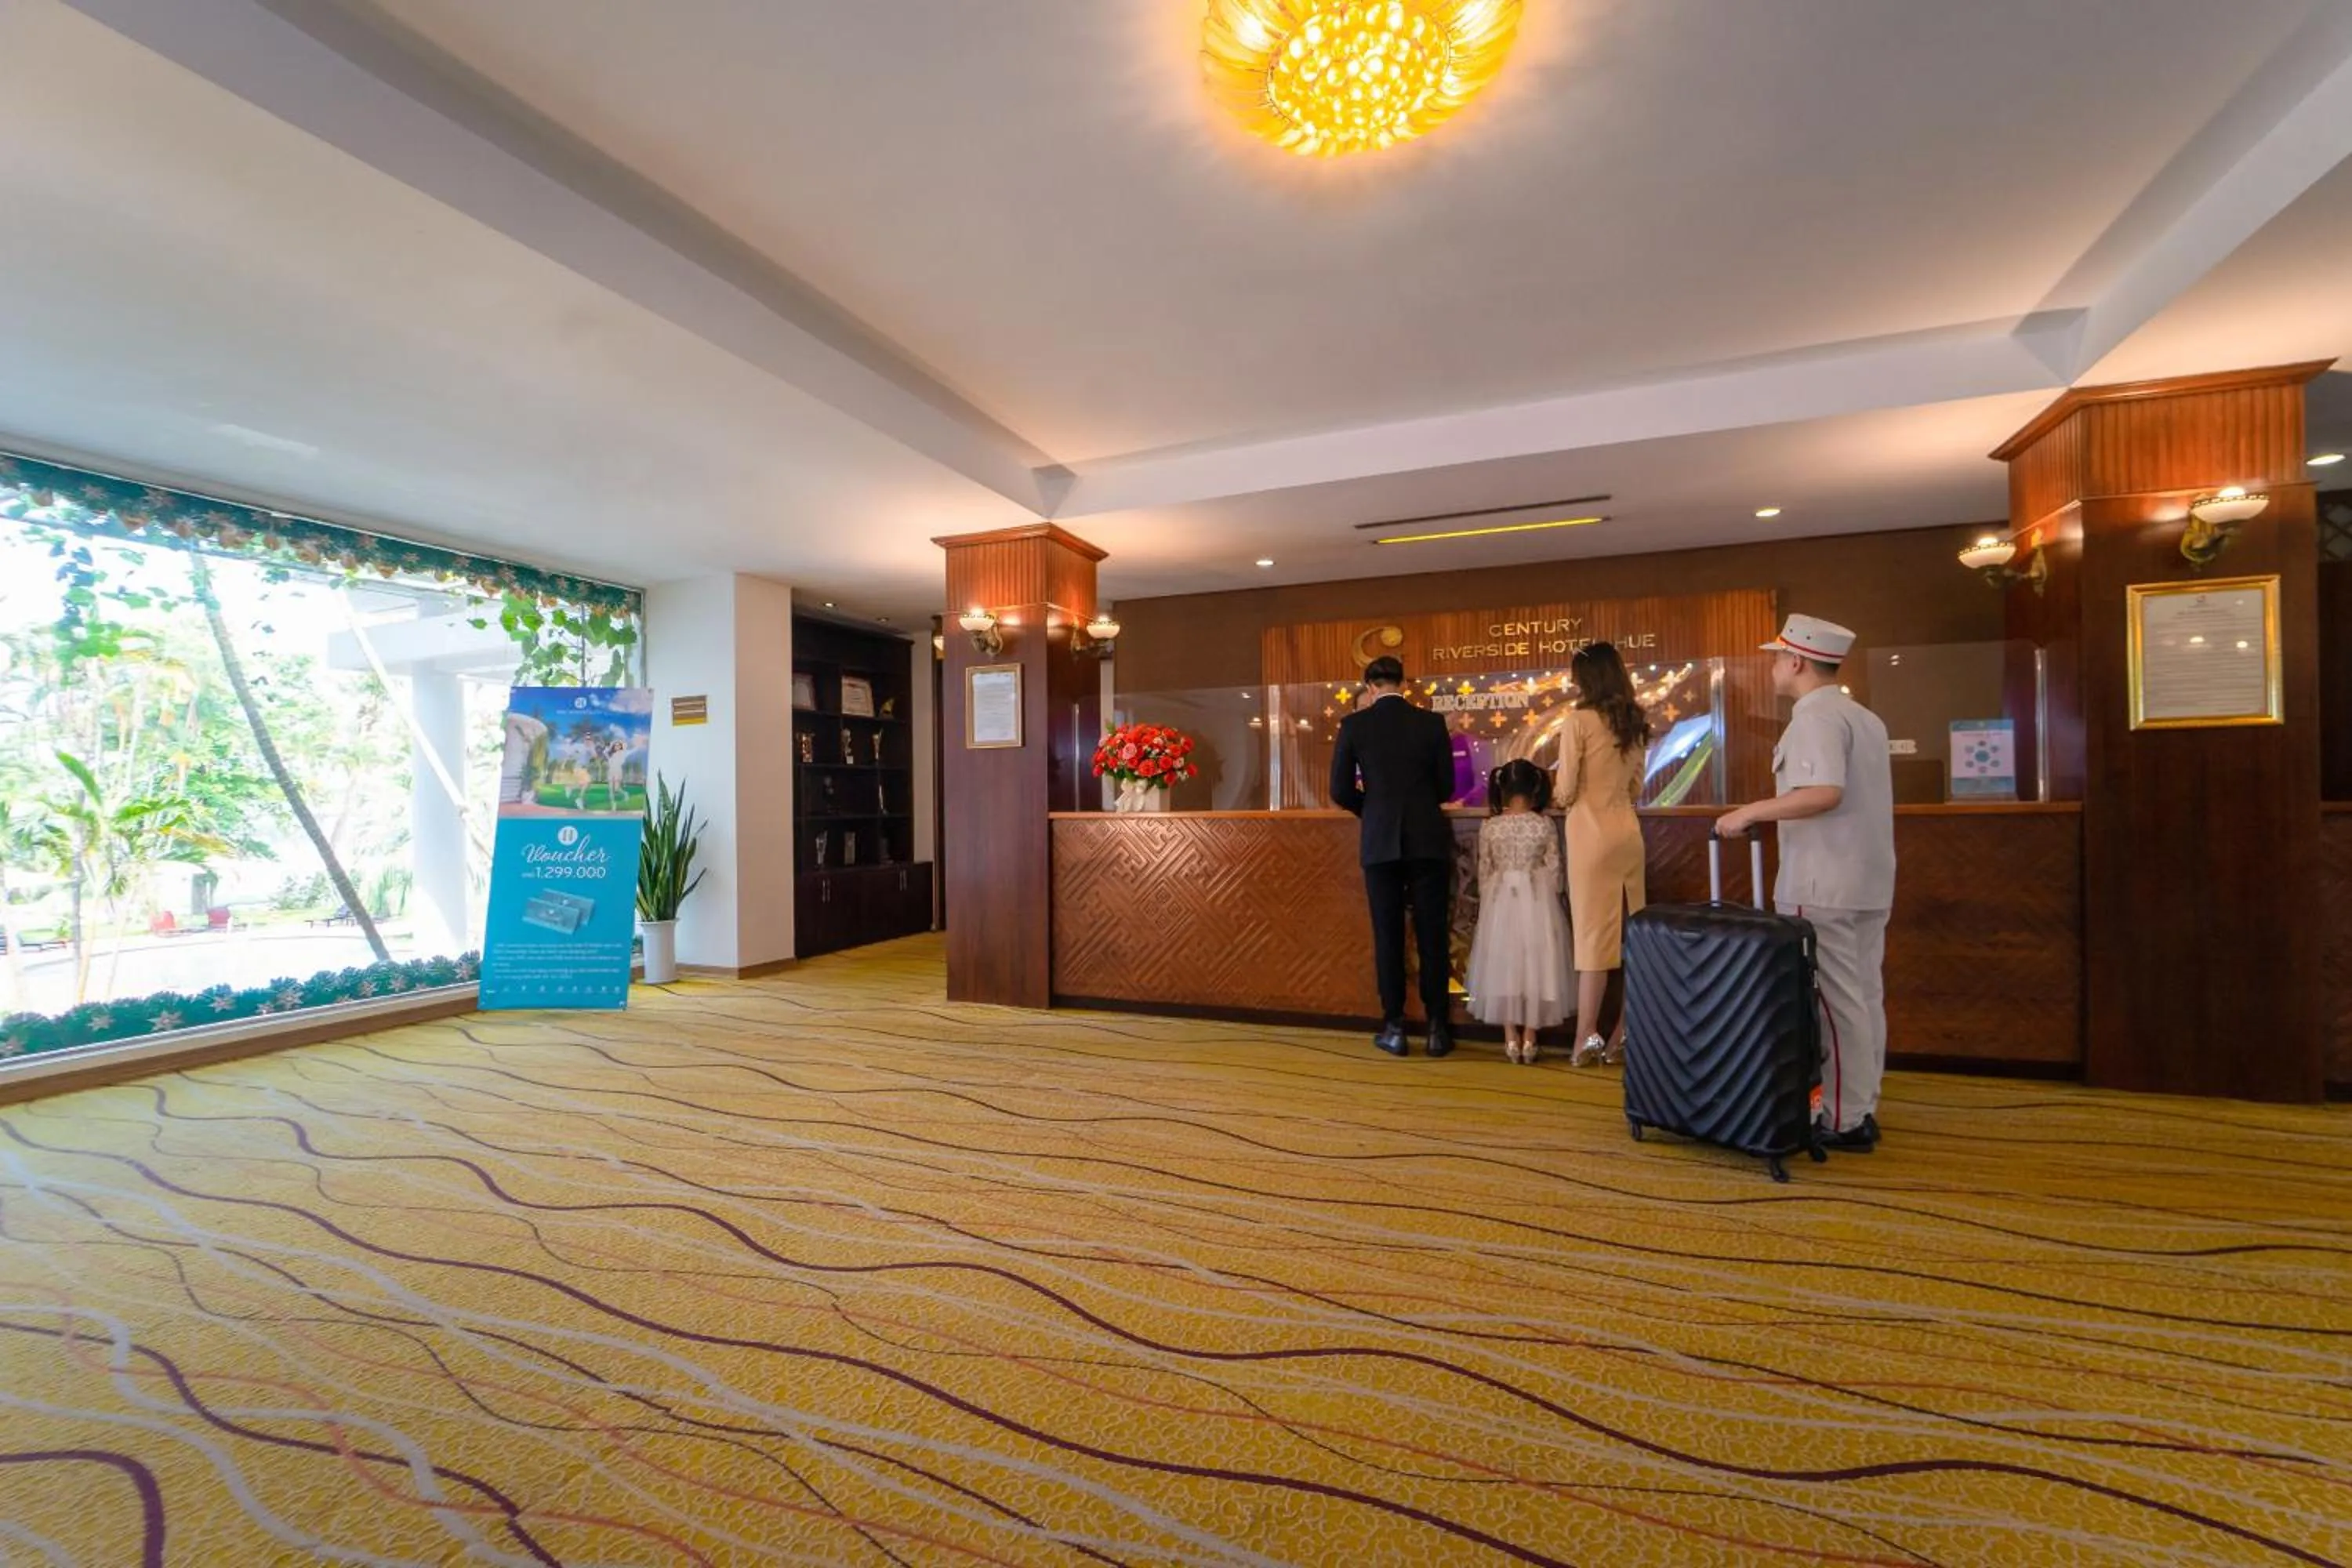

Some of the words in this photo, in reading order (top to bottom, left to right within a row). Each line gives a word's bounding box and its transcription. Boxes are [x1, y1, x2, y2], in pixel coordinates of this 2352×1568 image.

[1489, 618, 1582, 637] CENTURY
[1432, 641, 1530, 660] RIVERSIDE
[1615, 633, 1656, 650] HUE
[1432, 691, 1529, 712] RECEPTION
[521, 833, 611, 863] Voucher
[535, 866, 607, 879] 1.299.000
